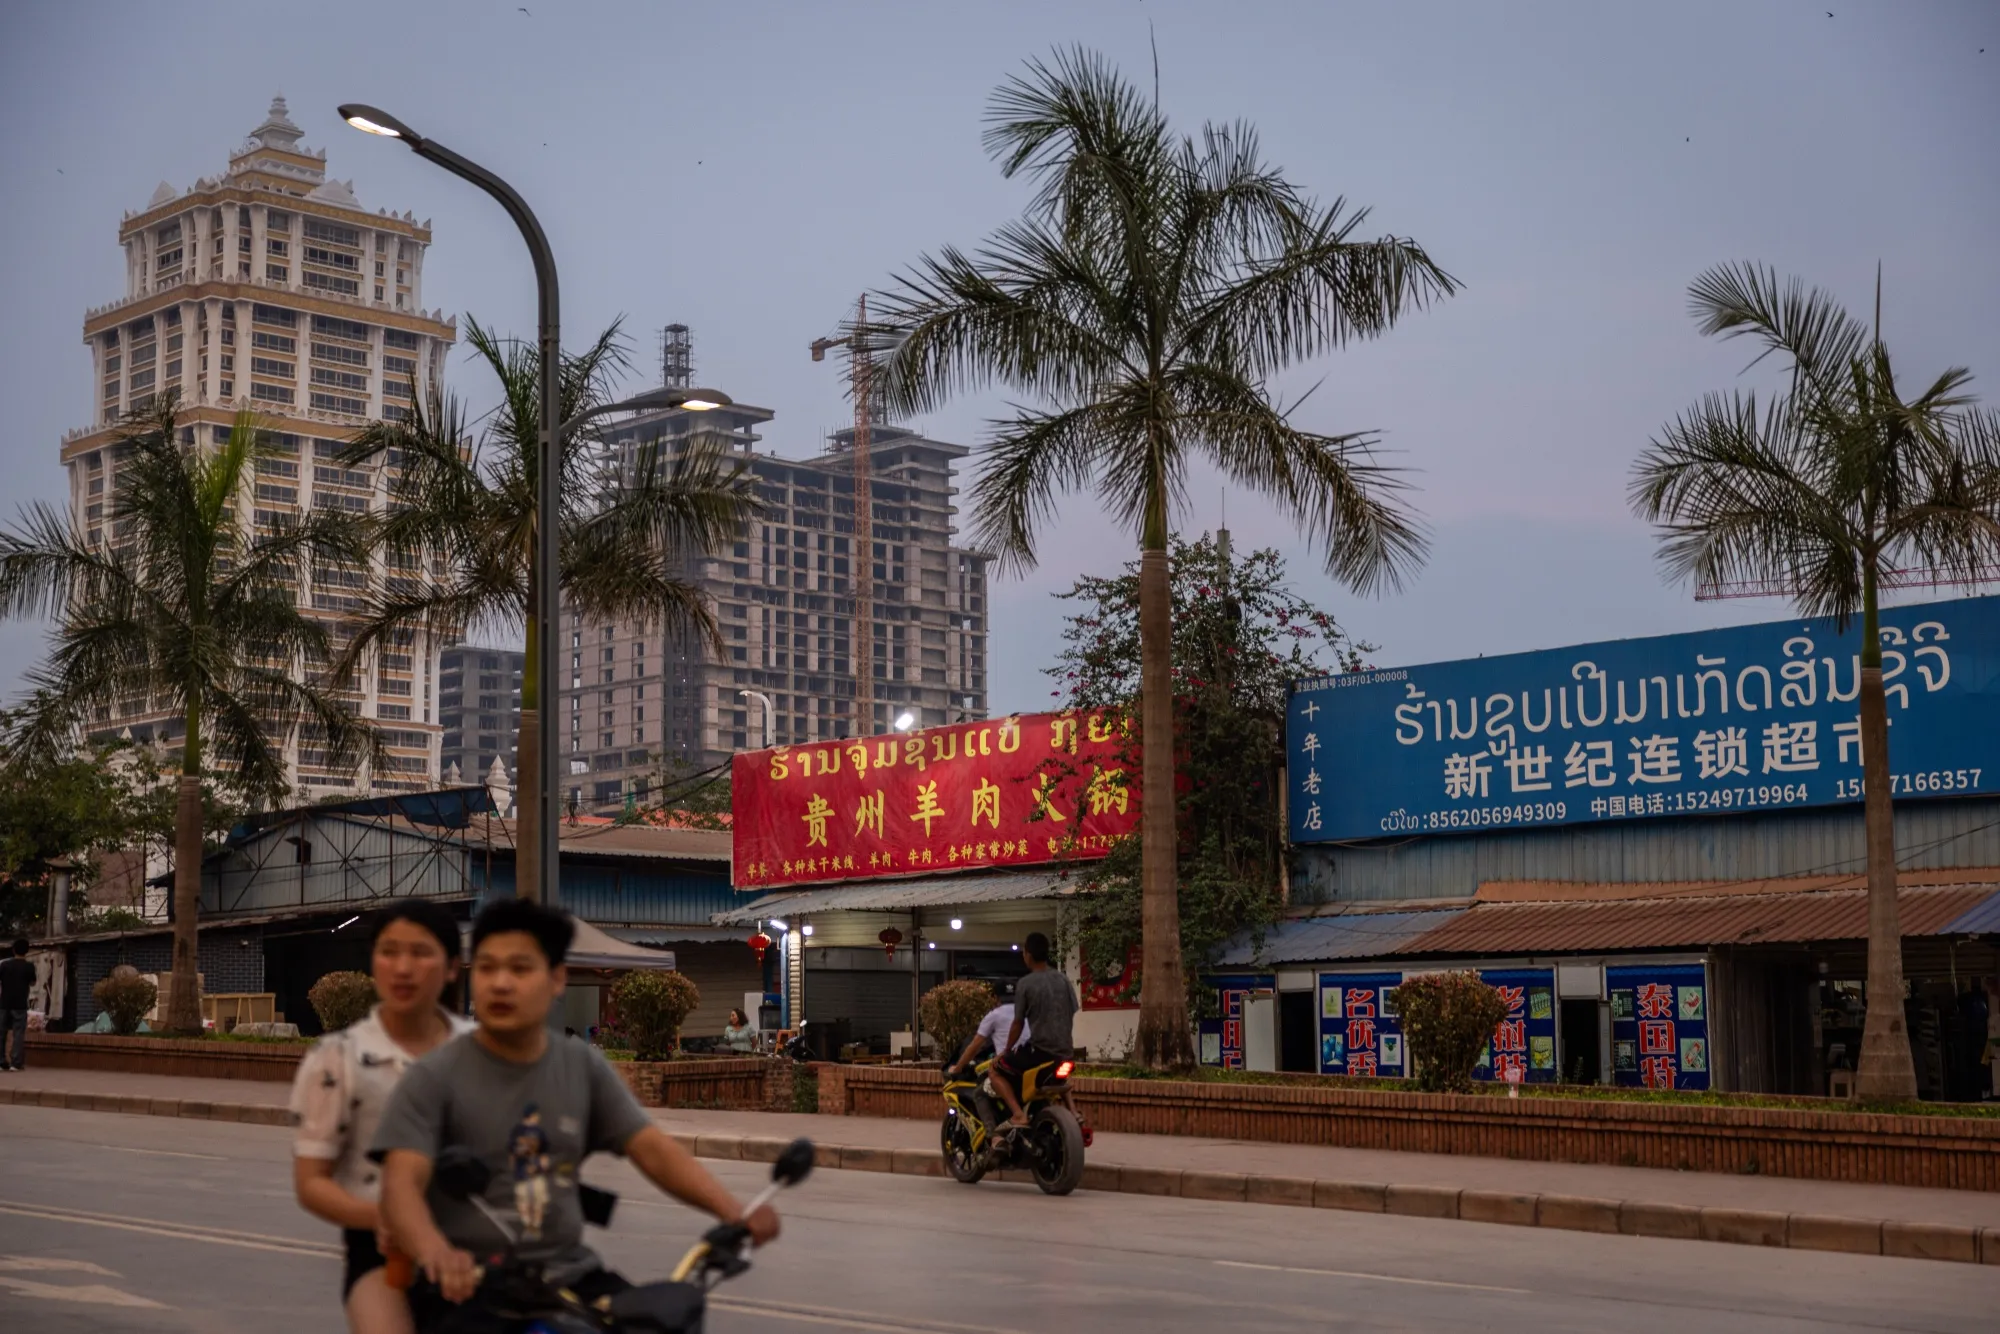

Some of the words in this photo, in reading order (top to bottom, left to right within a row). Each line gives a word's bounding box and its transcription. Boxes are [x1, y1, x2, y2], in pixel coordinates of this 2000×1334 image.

[1301, 701, 1322, 830] 十年老店
[1444, 714, 1892, 800] 新世纪连锁超市
[1591, 783, 1808, 818] 中国电话:15249719964
[1836, 768, 1982, 799] 157166357
[801, 765, 1129, 848] 贵州羊肉火锅
